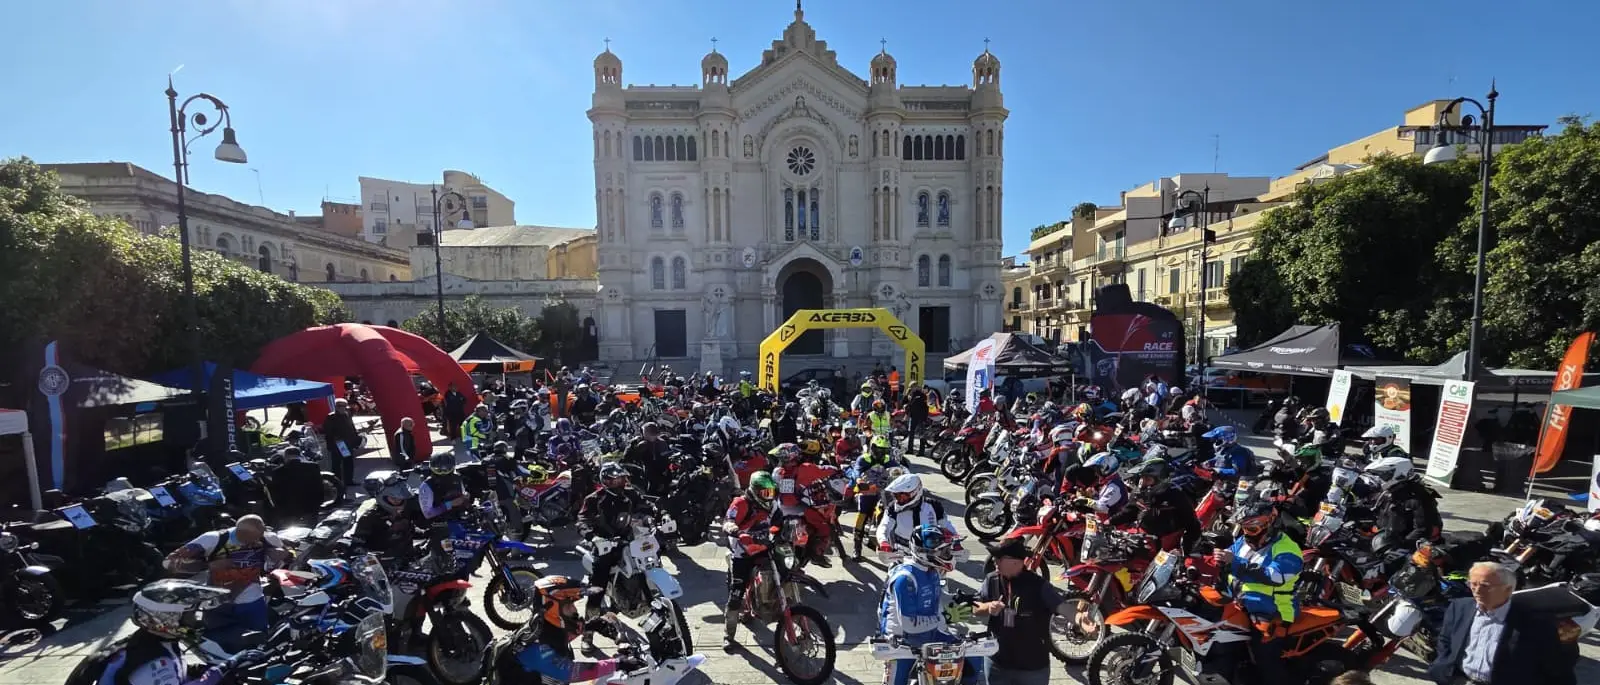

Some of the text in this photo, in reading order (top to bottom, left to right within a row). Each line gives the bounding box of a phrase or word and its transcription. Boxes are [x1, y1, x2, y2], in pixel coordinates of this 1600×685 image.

[809, 313, 876, 322] ACERBIS
[1144, 343, 1174, 351] RACE
[224, 378, 237, 452] ORBIDELLI
